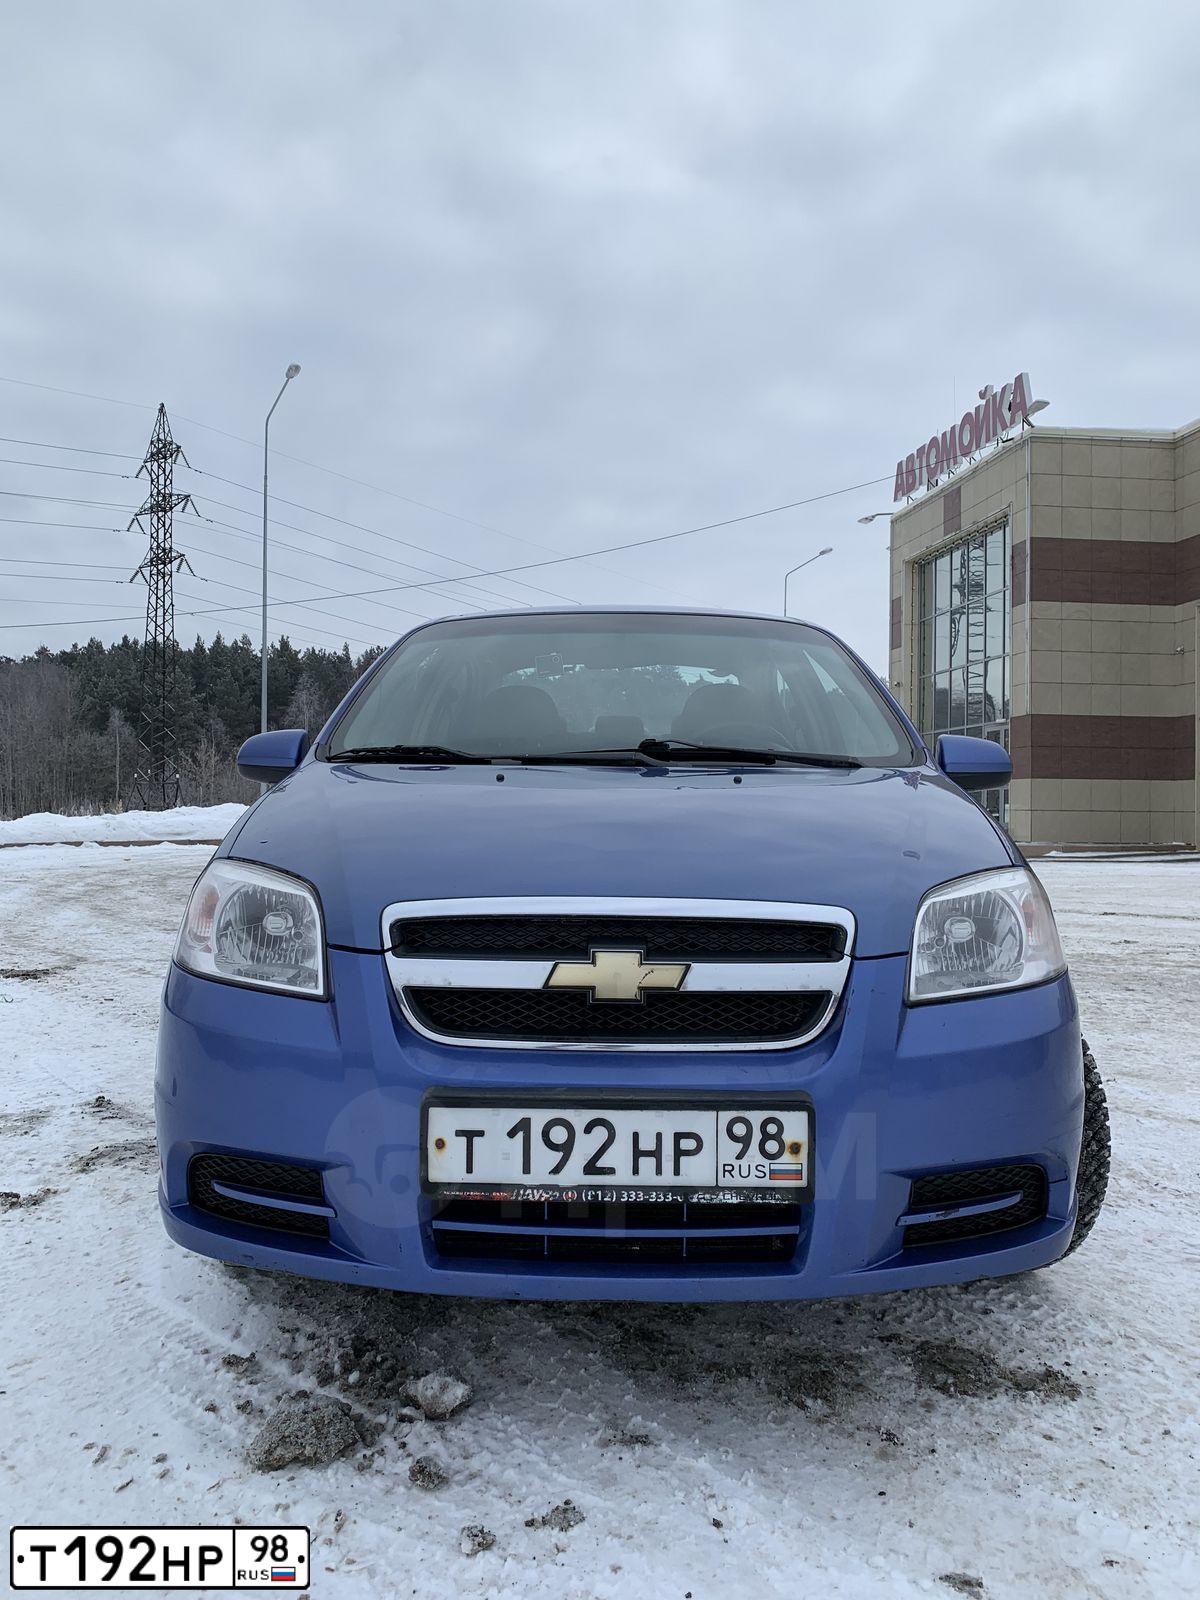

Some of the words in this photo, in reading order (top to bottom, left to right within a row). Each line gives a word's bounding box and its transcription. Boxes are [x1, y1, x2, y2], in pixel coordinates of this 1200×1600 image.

[893, 373, 1032, 502] АВТОМОЙКА
[726, 1116, 785, 1160] 98
[722, 1163, 766, 1179] RUS
